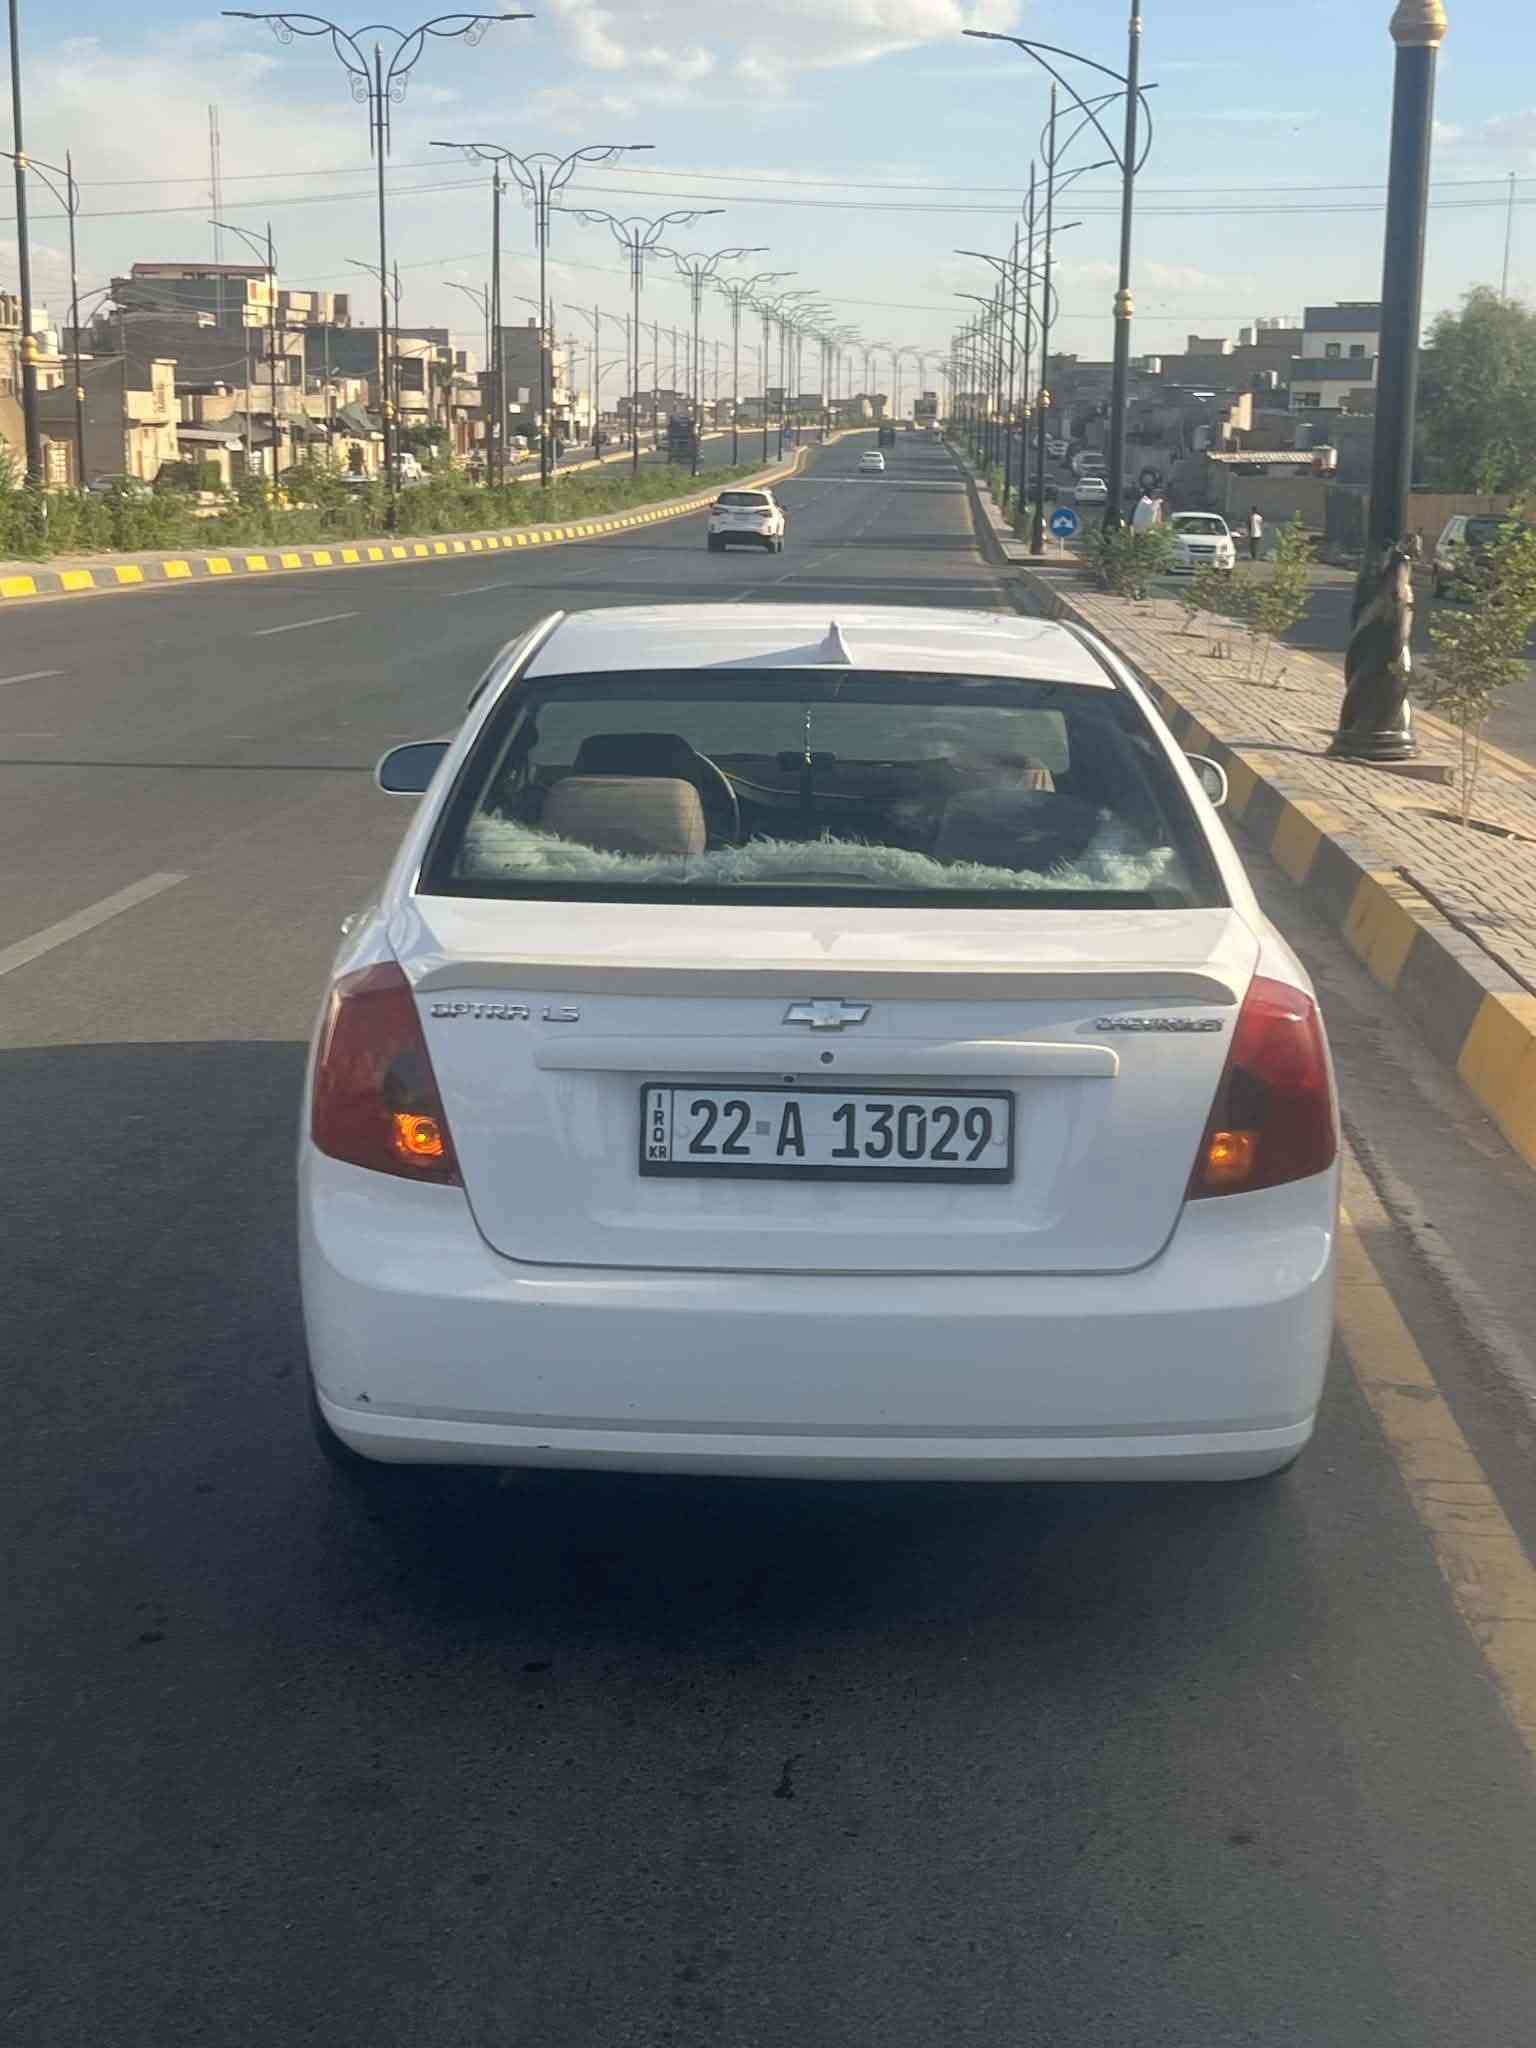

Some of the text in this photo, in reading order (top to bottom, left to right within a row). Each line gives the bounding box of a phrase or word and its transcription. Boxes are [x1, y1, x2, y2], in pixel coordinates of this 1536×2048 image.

[542, 1005, 580, 1023] LS
[689, 1099, 993, 1161] 22 A 13029
